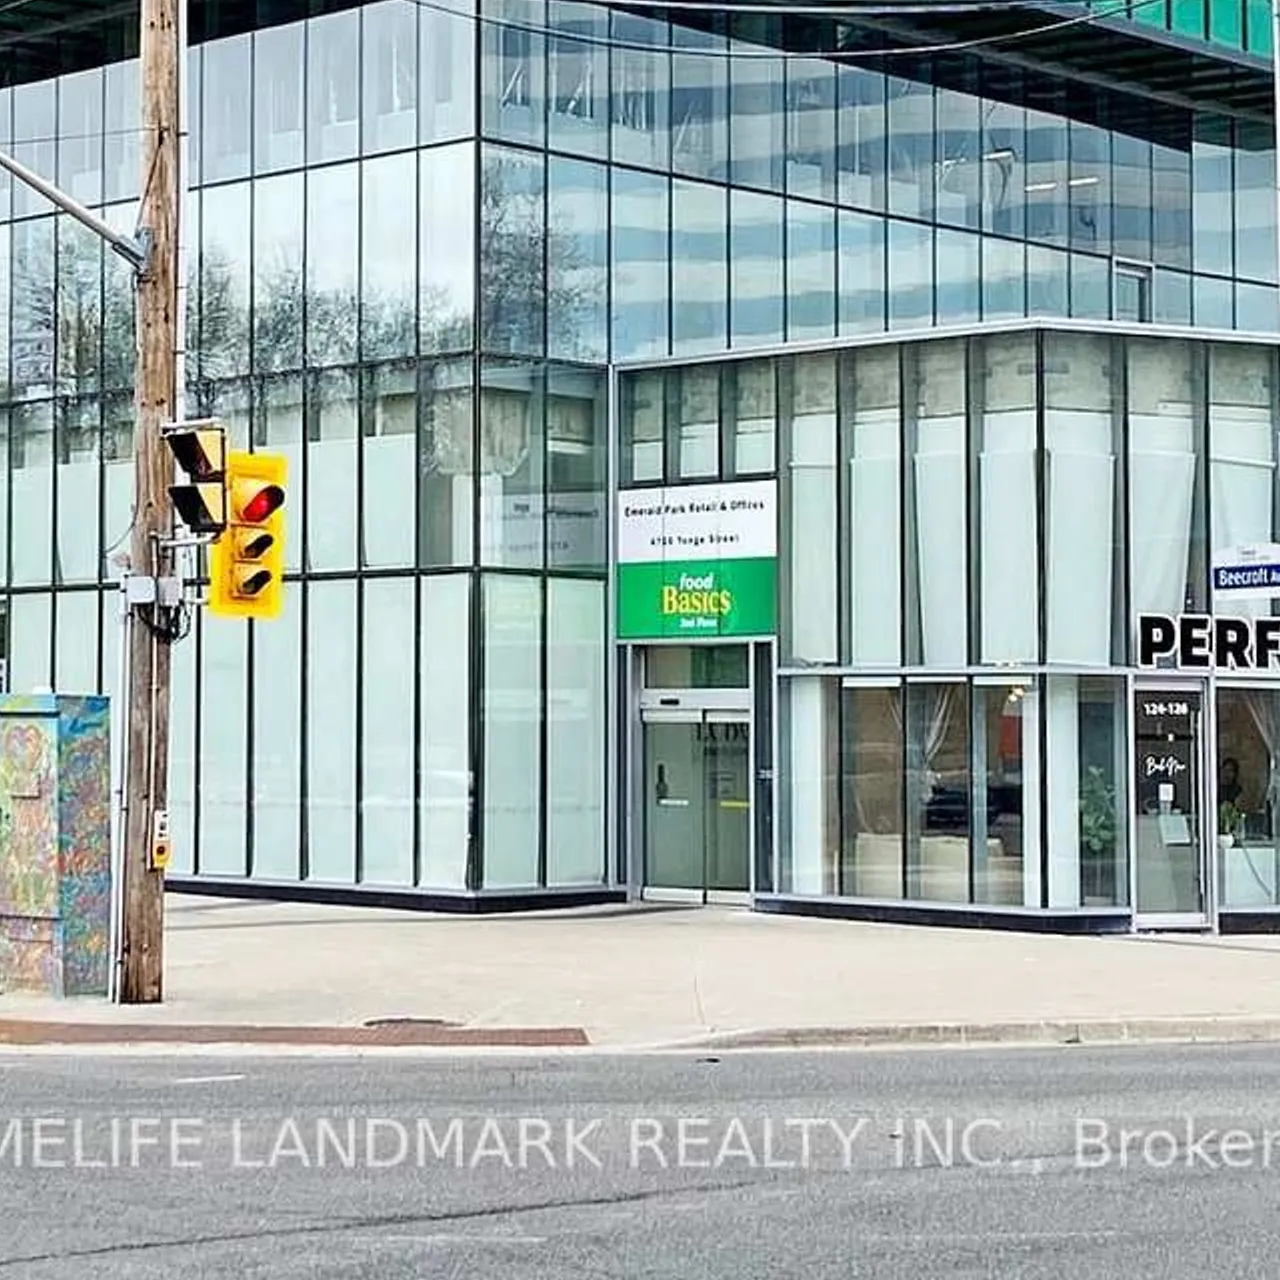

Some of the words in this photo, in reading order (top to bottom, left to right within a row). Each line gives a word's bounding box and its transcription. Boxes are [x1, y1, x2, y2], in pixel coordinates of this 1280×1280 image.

[664, 504, 686, 515] Park
[720, 501, 727, 512] &
[677, 535, 705, 547] Yonge
[709, 533, 739, 545] Street
[680, 572, 714, 590] food
[1219, 567, 1268, 586] Beecroft
[663, 585, 731, 615] Basics
